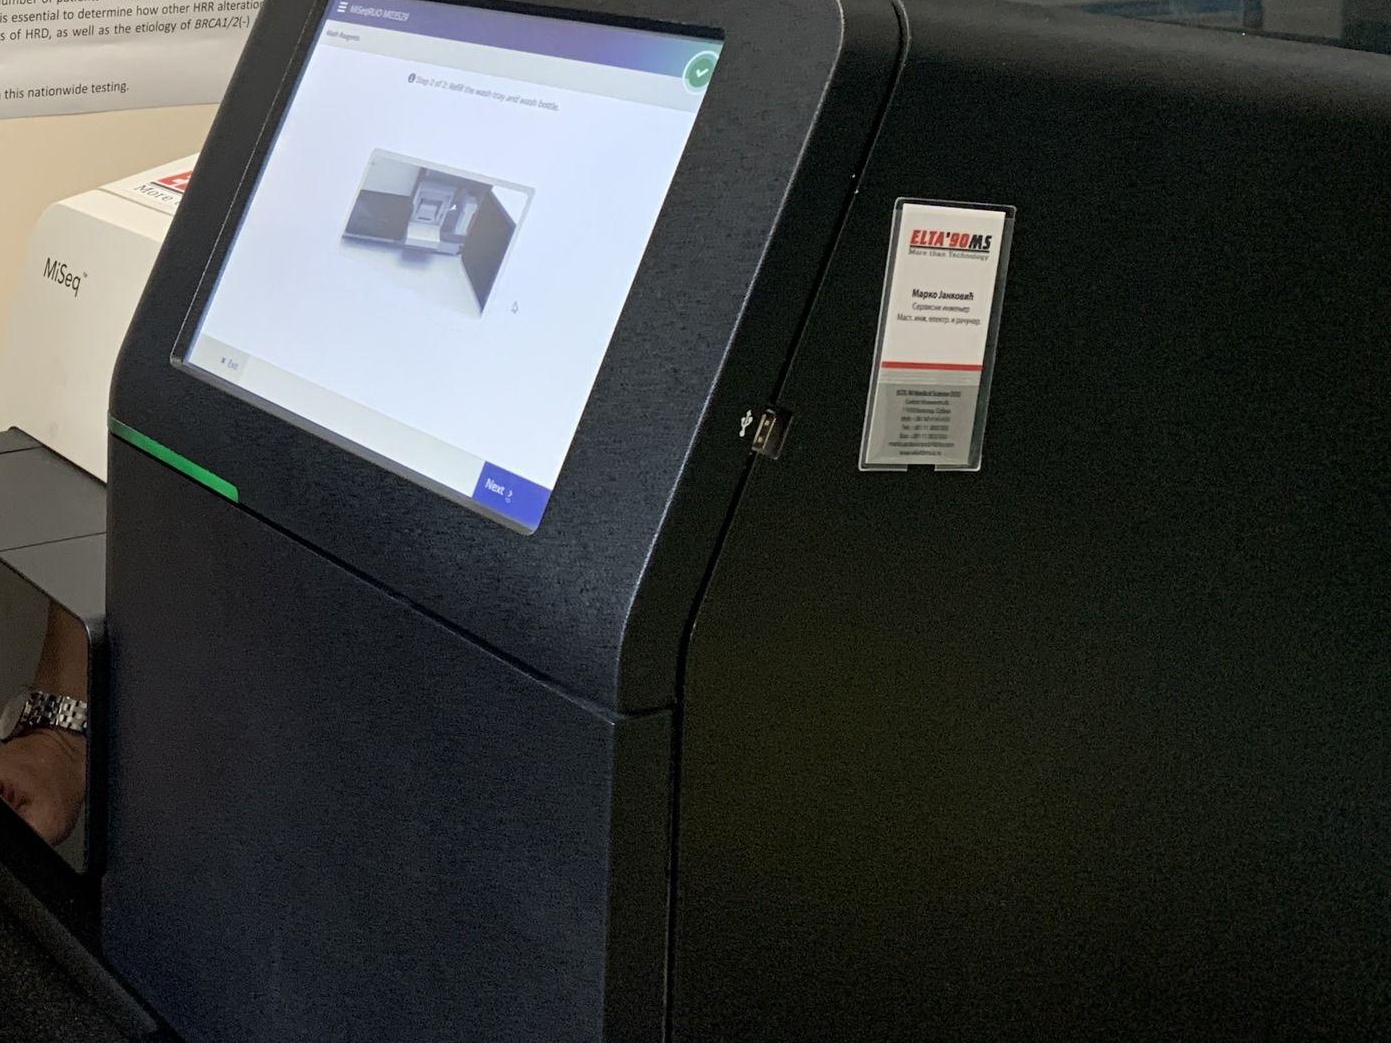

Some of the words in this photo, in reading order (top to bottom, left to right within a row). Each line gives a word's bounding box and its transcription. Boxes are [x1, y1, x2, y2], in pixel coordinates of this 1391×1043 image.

[4, 88, 24, 99] this
[27, 84, 88, 98] nationwide
[91, 82, 129, 93] testing.
[134, 183, 175, 202] More
[485, 478, 505, 496] Next
